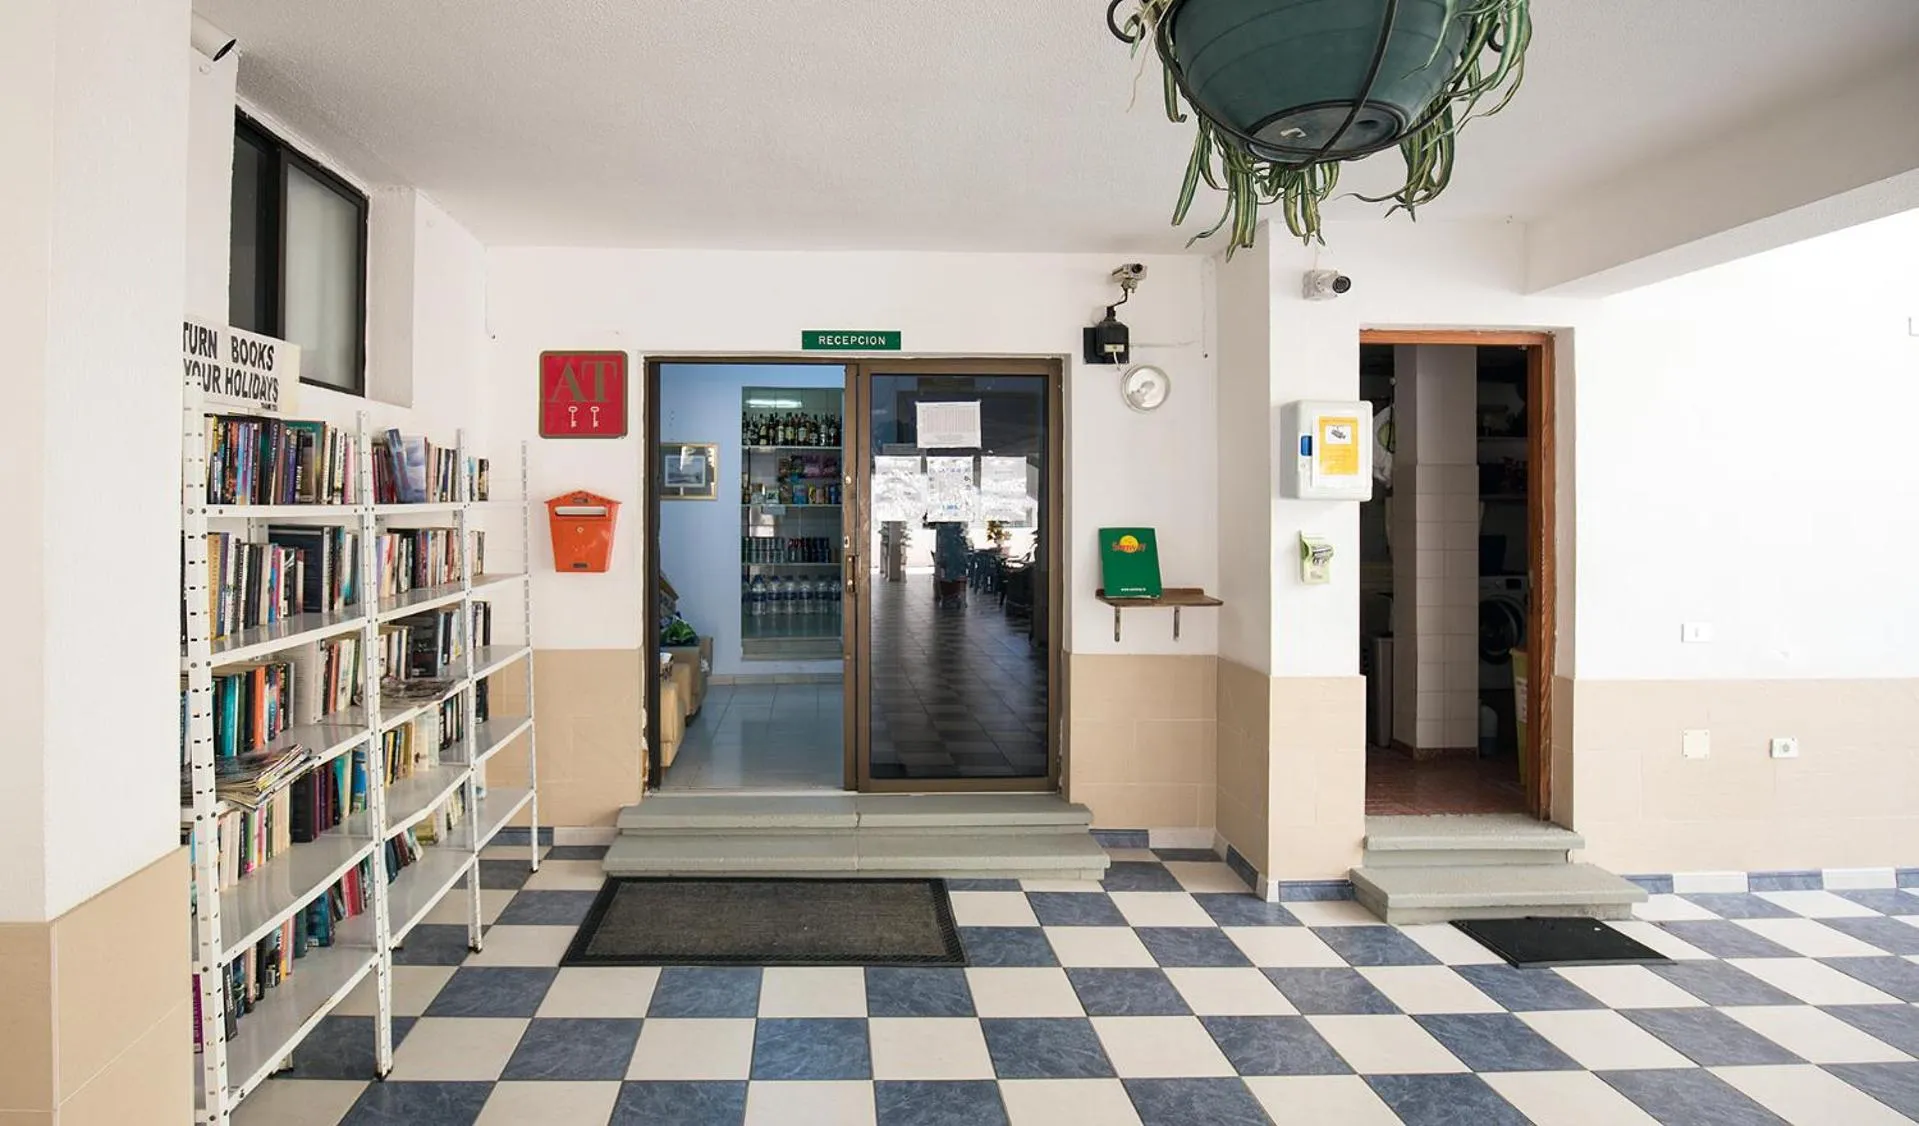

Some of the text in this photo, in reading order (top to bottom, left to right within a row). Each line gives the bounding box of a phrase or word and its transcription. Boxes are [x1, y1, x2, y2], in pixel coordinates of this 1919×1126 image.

[230, 335, 274, 371] BOOKS
[818, 335, 886, 345] RECEPCION
[225, 367, 279, 403] HOLIDAYS
[551, 360, 618, 402] AT
